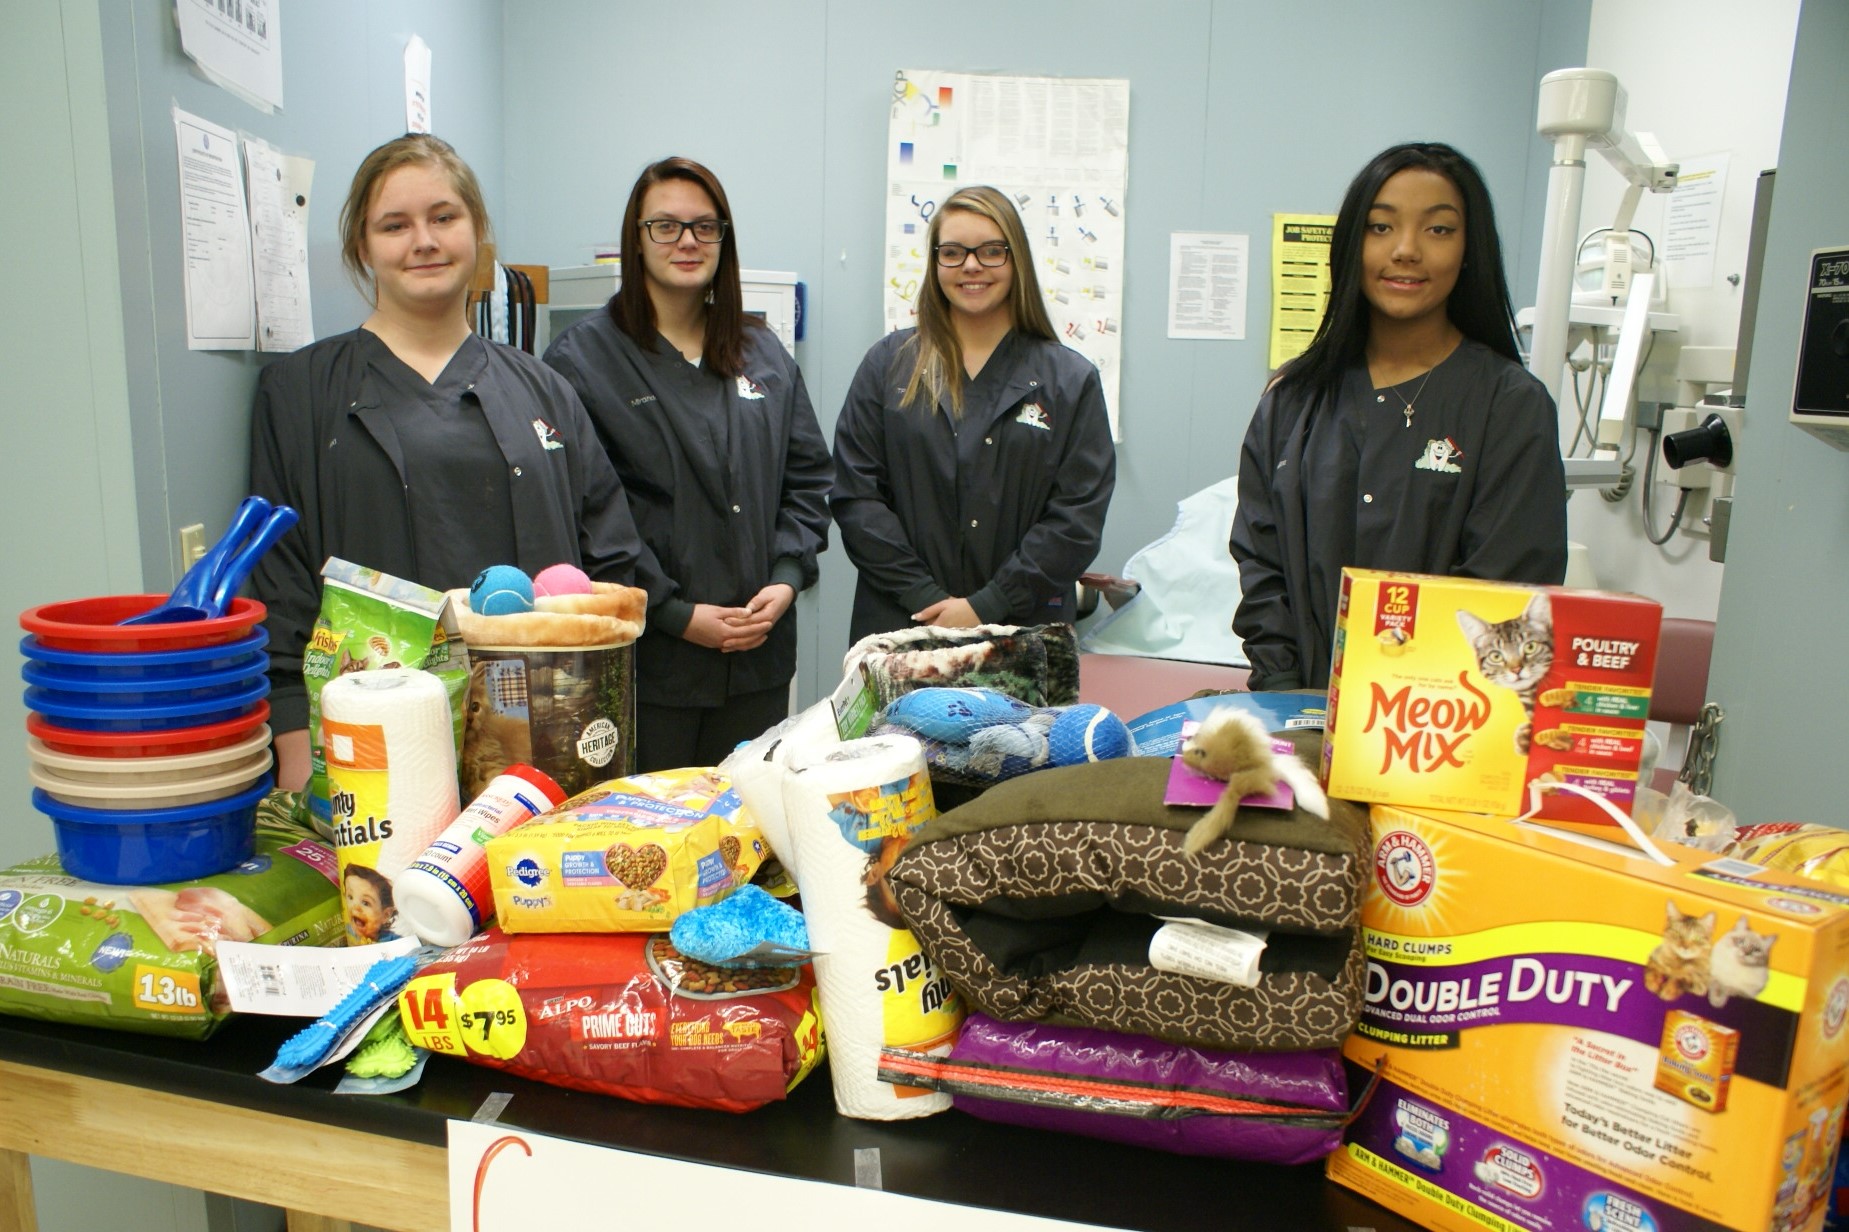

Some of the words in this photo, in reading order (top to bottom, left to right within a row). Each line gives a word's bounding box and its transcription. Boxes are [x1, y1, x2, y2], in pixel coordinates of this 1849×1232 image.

[1301, 226, 1326, 235] SAFETY
[1386, 586, 1409, 605] 12
[1380, 613, 1412, 623] VARIETY
[1383, 603, 1410, 614] CUP
[1385, 619, 1405, 628] PACK
[1572, 637, 1640, 656] POULTRY
[1576, 652, 1589, 666] &
[1592, 654, 1631, 669] BEEF
[586, 721, 611, 736] AMERICAN
[581, 731, 616, 754] HERITAGE
[478, 810, 500, 824] Wipes
[296, 847, 325, 862] 25
[1377, 841, 1393, 869] ARM
[1400, 835, 1432, 884] HAMMER
[507, 866, 550, 878] Pedigree
[513, 895, 547, 908] Puppy
[1367, 933, 1399, 950] HARD
[1403, 942, 1452, 954] CLUMPS
[1379, 948, 1394, 959] Easy
[1395, 951, 1426, 963] Scooping
[59, 972, 103, 988] MINERALS
[1364, 961, 1503, 1012] DOUBLE
[1507, 959, 1633, 1012] DUTY
[404, 988, 449, 1031] 14
[539, 995, 592, 1020] ALPO
[1362, 1003, 1403, 1021] DVANCED
[1404, 1013, 1428, 1023] DUAL
[1429, 1013, 1456, 1023] ODOR
[1456, 1006, 1501, 1021] CONTROL
[582, 1013, 622, 1039] PRIME
[625, 1012, 656, 1037] CUTS
[1358, 1023, 1409, 1044] CLUMPING
[1410, 1034, 1449, 1046] LITTER
[423, 1035, 454, 1050] LBS
[614, 1042, 629, 1050] BEEF
[703, 1033, 724, 1045] NEEDS
[1586, 1041, 1616, 1055] Secret
[1616, 1052, 1627, 1060] in
[1587, 1051, 1613, 1065] Litter
[1397, 1098, 1450, 1131] ELIMINATES
[1410, 1114, 1434, 1133] BOTH
[1561, 1115, 1579, 1129] for
[1581, 1125, 1620, 1146] Better
[1622, 1141, 1656, 1160] Odor
[1564, 1102, 1608, 1128] Today's
[1612, 1122, 1653, 1144] Better
[1655, 1139, 1693, 1159] Litter
[1501, 1147, 1532, 1166] SOLID
[1495, 1154, 1535, 1179] CLUMPS
[1354, 1148, 1371, 1163] ARM
[1370, 1156, 1377, 1167] &
[1415, 1179, 1444, 1200] Double
[1445, 1194, 1464, 1212] Duty
[1466, 1204, 1506, 1232] Clumping
[1606, 1194, 1643, 1213] FRESH
[1604, 1205, 1642, 1229] SCENT
